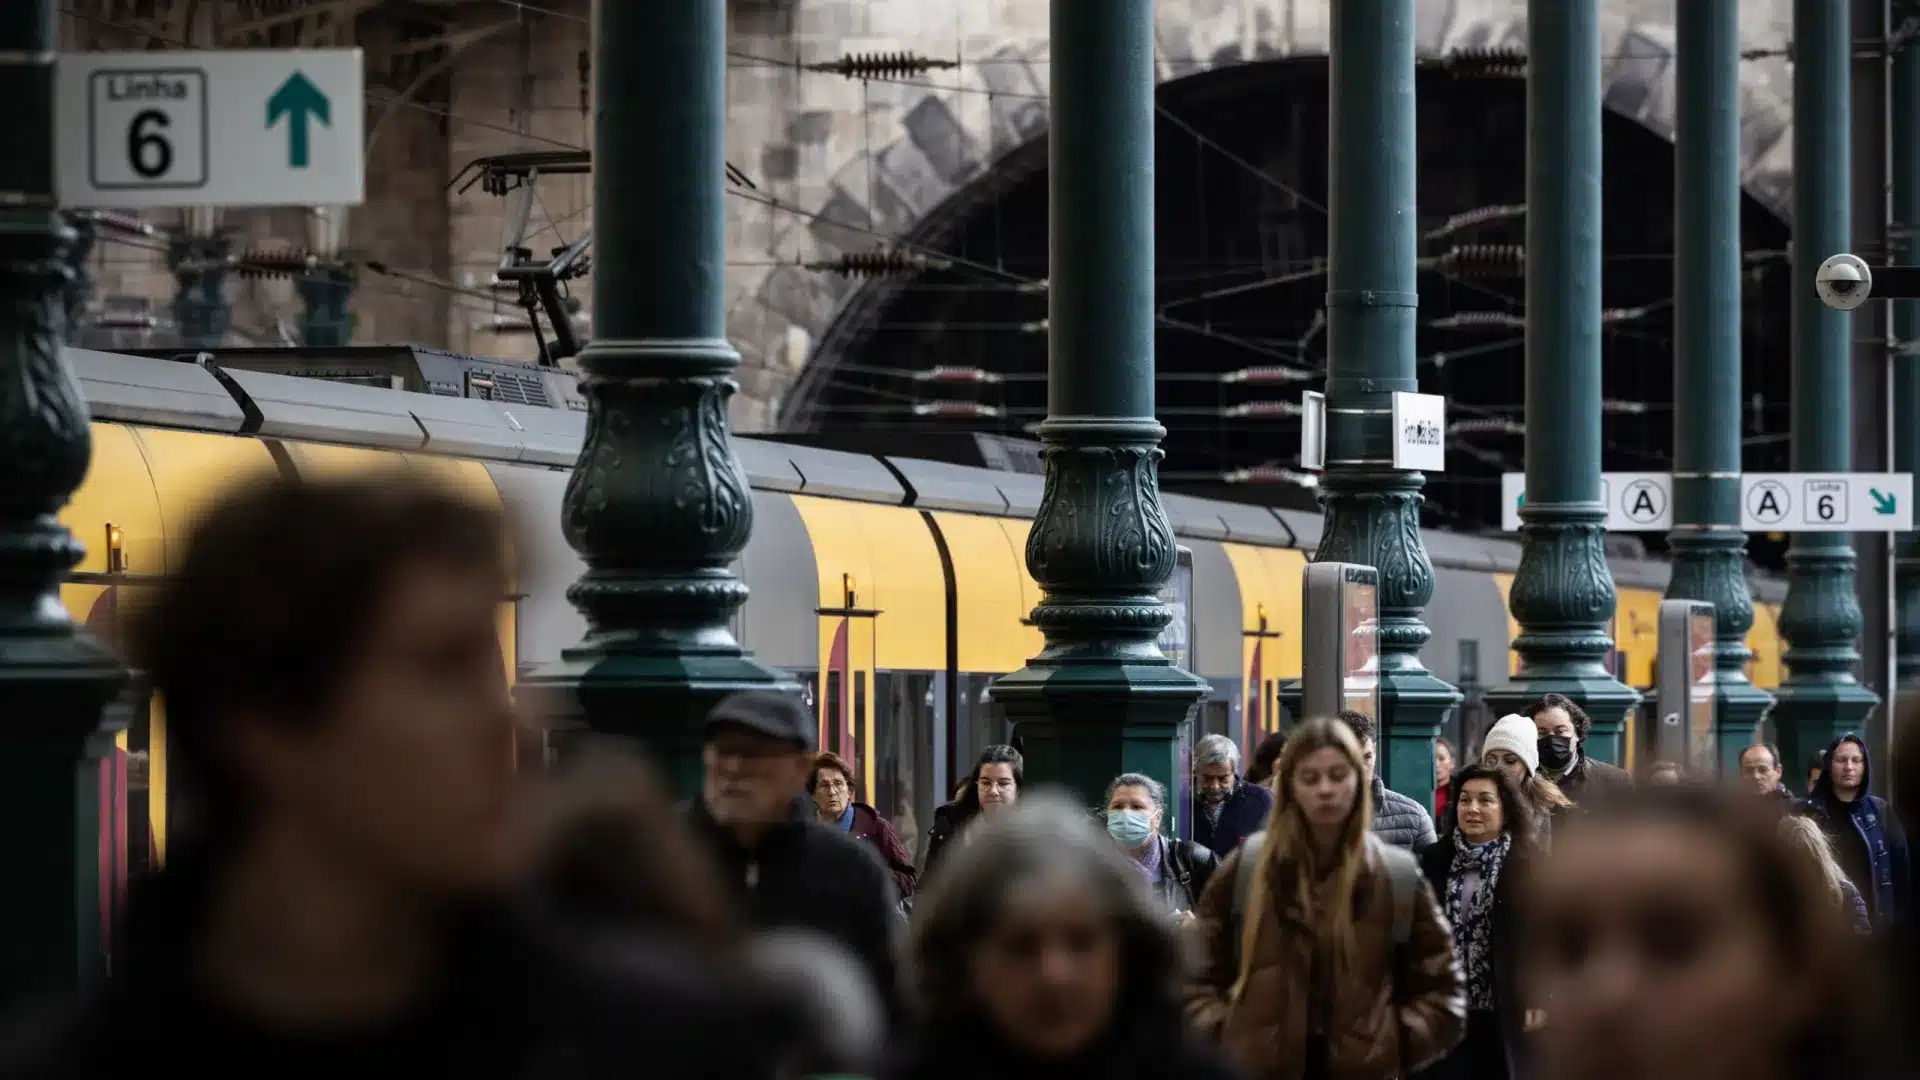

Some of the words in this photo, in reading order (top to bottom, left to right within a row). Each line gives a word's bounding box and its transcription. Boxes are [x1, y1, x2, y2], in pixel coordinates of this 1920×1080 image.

[107, 76, 187, 100] Linha
[127, 108, 173, 179] 6
[1632, 489, 1656, 515] A
[1757, 489, 1780, 515] A
[1817, 494, 1834, 519] 6
